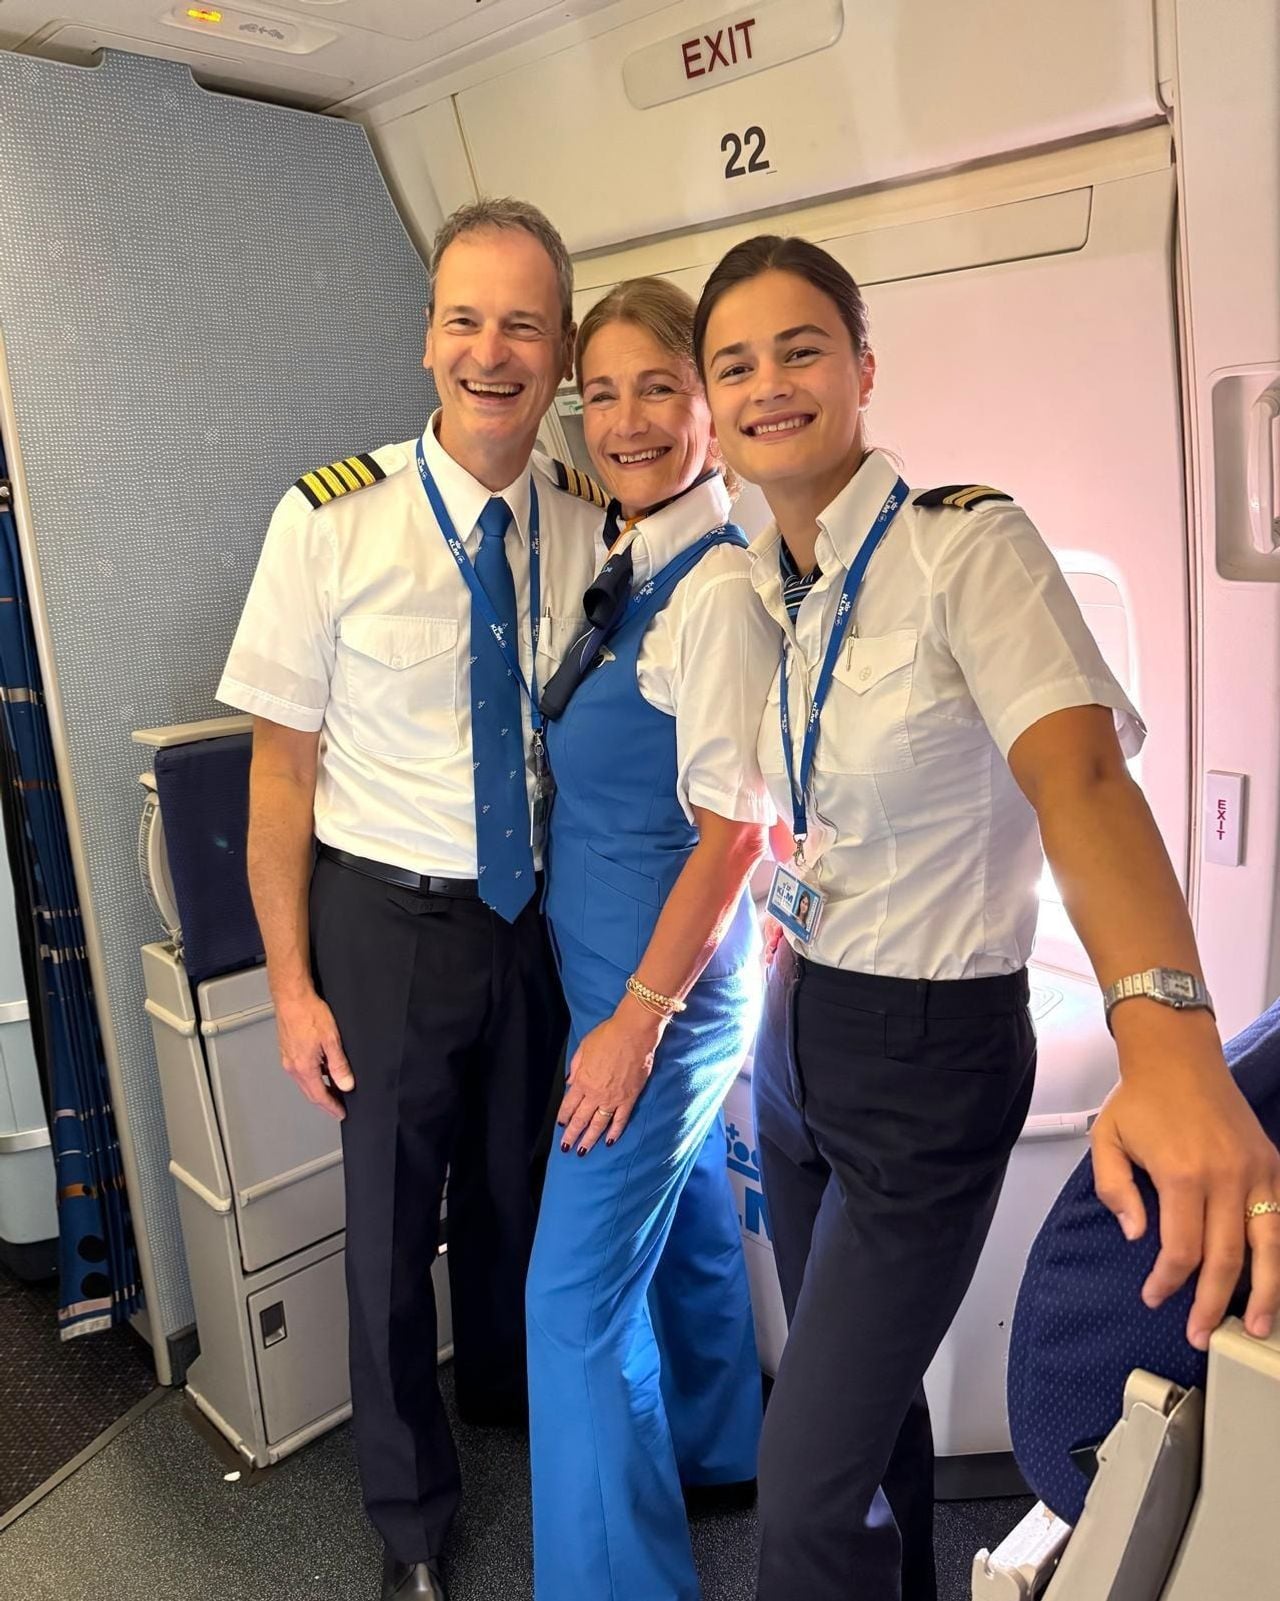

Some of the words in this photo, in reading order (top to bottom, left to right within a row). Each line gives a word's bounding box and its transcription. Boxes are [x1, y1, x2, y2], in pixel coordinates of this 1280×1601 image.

[681, 18, 756, 80] EXIT
[720, 125, 770, 179] 22
[882, 494, 896, 514] KLM
[448, 538, 460, 556] KLM
[639, 580, 655, 595] KLM
[837, 592, 849, 616] KLM
[490, 623, 502, 641] KLM
[809, 701, 818, 724] KLM
[1216, 798, 1227, 841] EXIT
